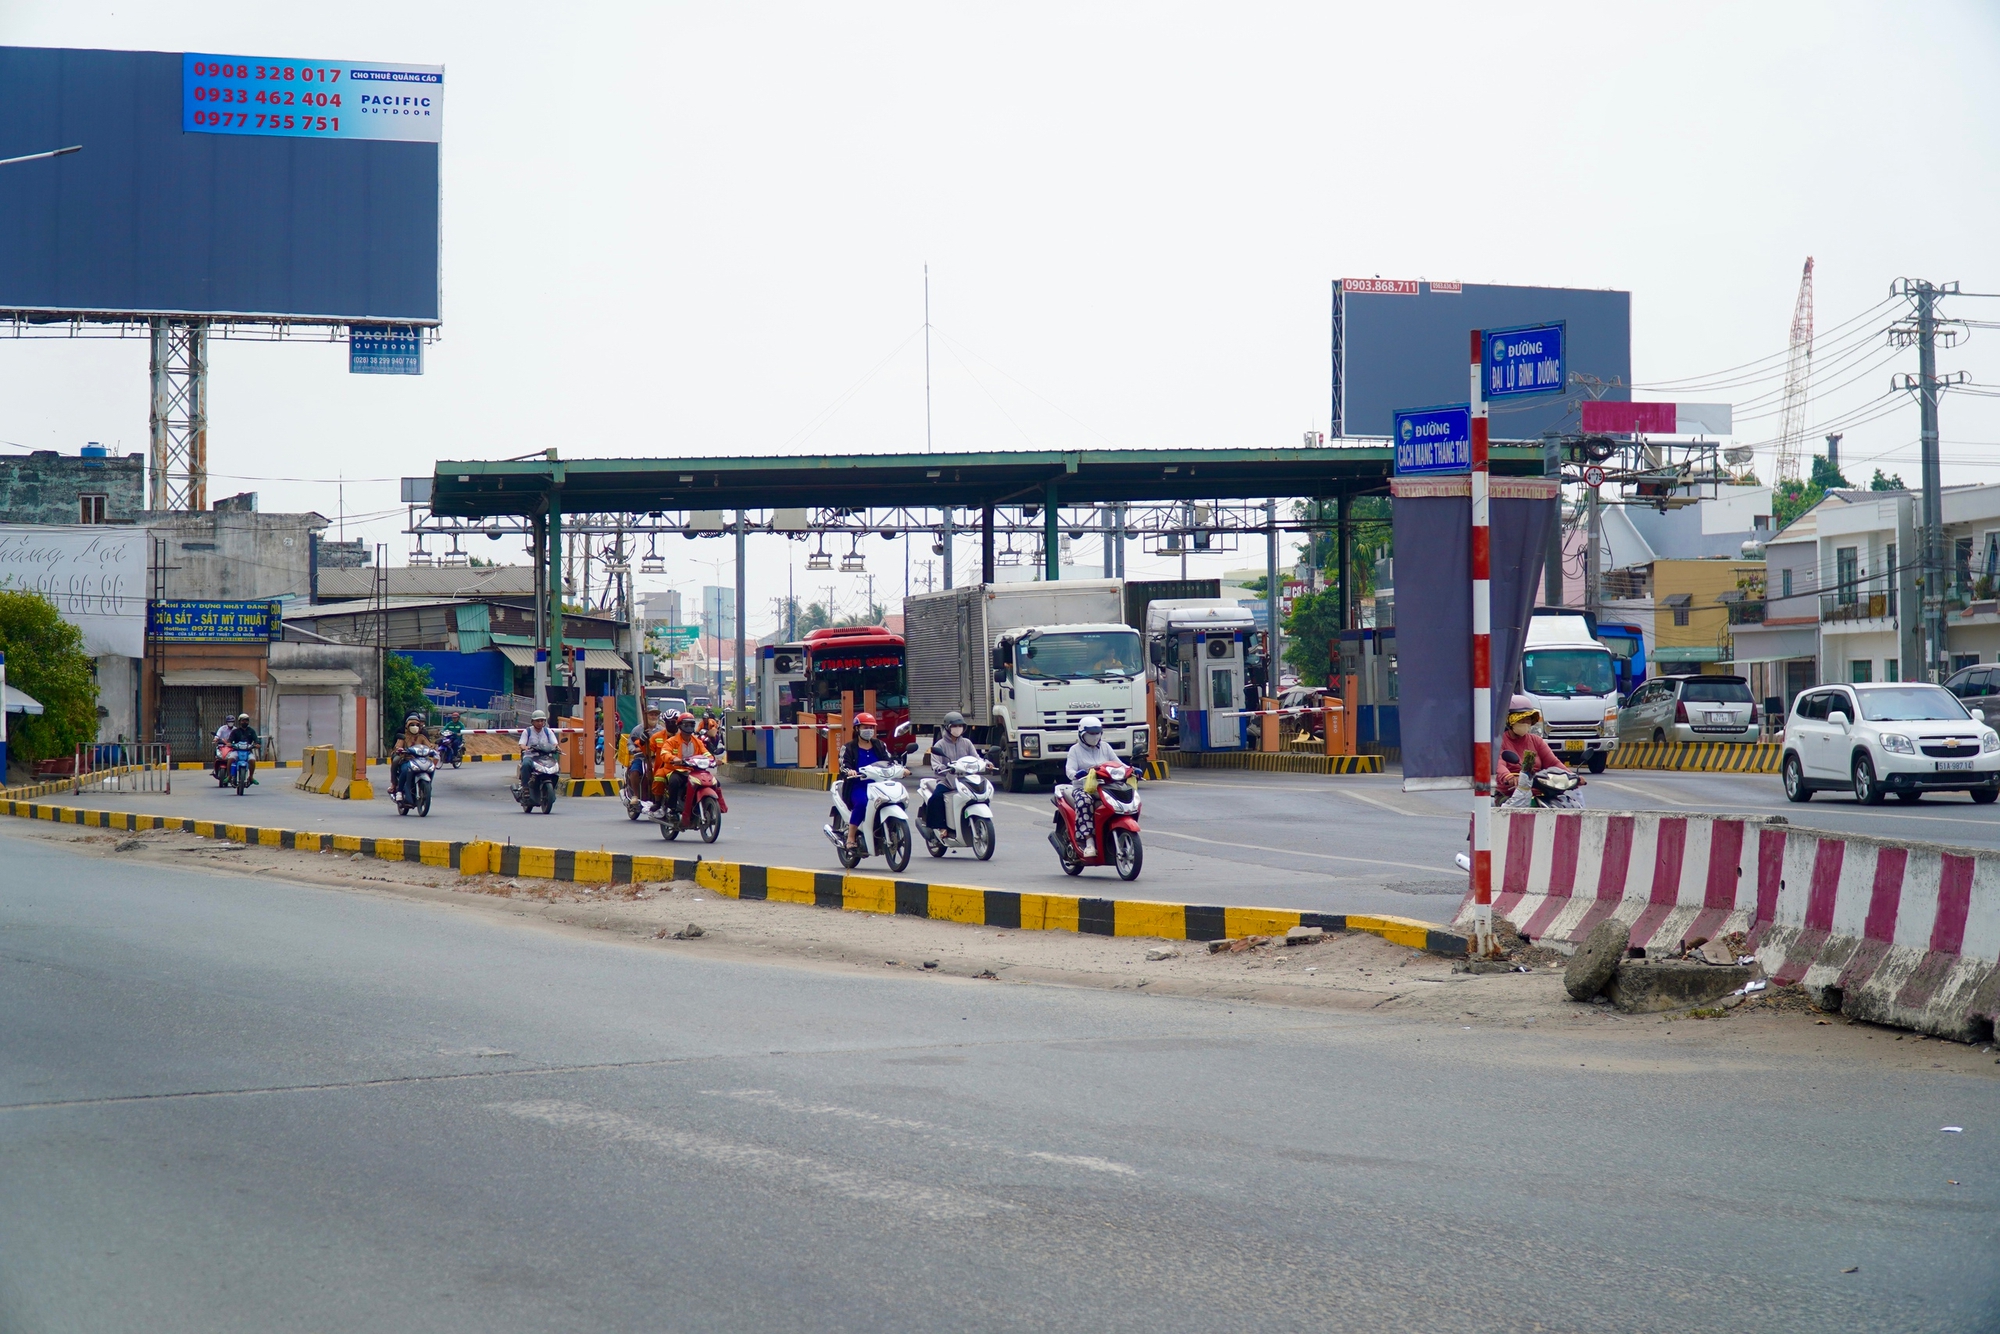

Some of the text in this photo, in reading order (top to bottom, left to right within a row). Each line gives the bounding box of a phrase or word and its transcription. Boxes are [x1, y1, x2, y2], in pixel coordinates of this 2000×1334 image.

[194, 61, 341, 82] 0908 328 017
[370, 72, 391, 80] THUÊ
[194, 86, 342, 107] 0933 462 404
[361, 95, 431, 107] PACIFIC
[361, 107, 430, 116] OUTDOOR
[194, 110, 339, 131] 0977 755 751
[1345, 279, 1416, 292] 0903.868.711
[354, 330, 415, 341] PACIFIC
[1508, 340, 1543, 357] ĐƯỜNG
[1492, 356, 1559, 391] ĐẠI LỘ BÌNH DƯƠNG
[1415, 421, 1450, 437] ĐƯỜNG
[1398, 435, 1469, 468] CÁCH MẠNG THÁNG TÁM
[174, 609, 192, 625] SẮT
[201, 609, 219, 625] SẮT
[221, 611, 235, 625] MỸ
[238, 612, 268, 627] THUẬT
[1068, 701, 1101, 709] ISUZU
